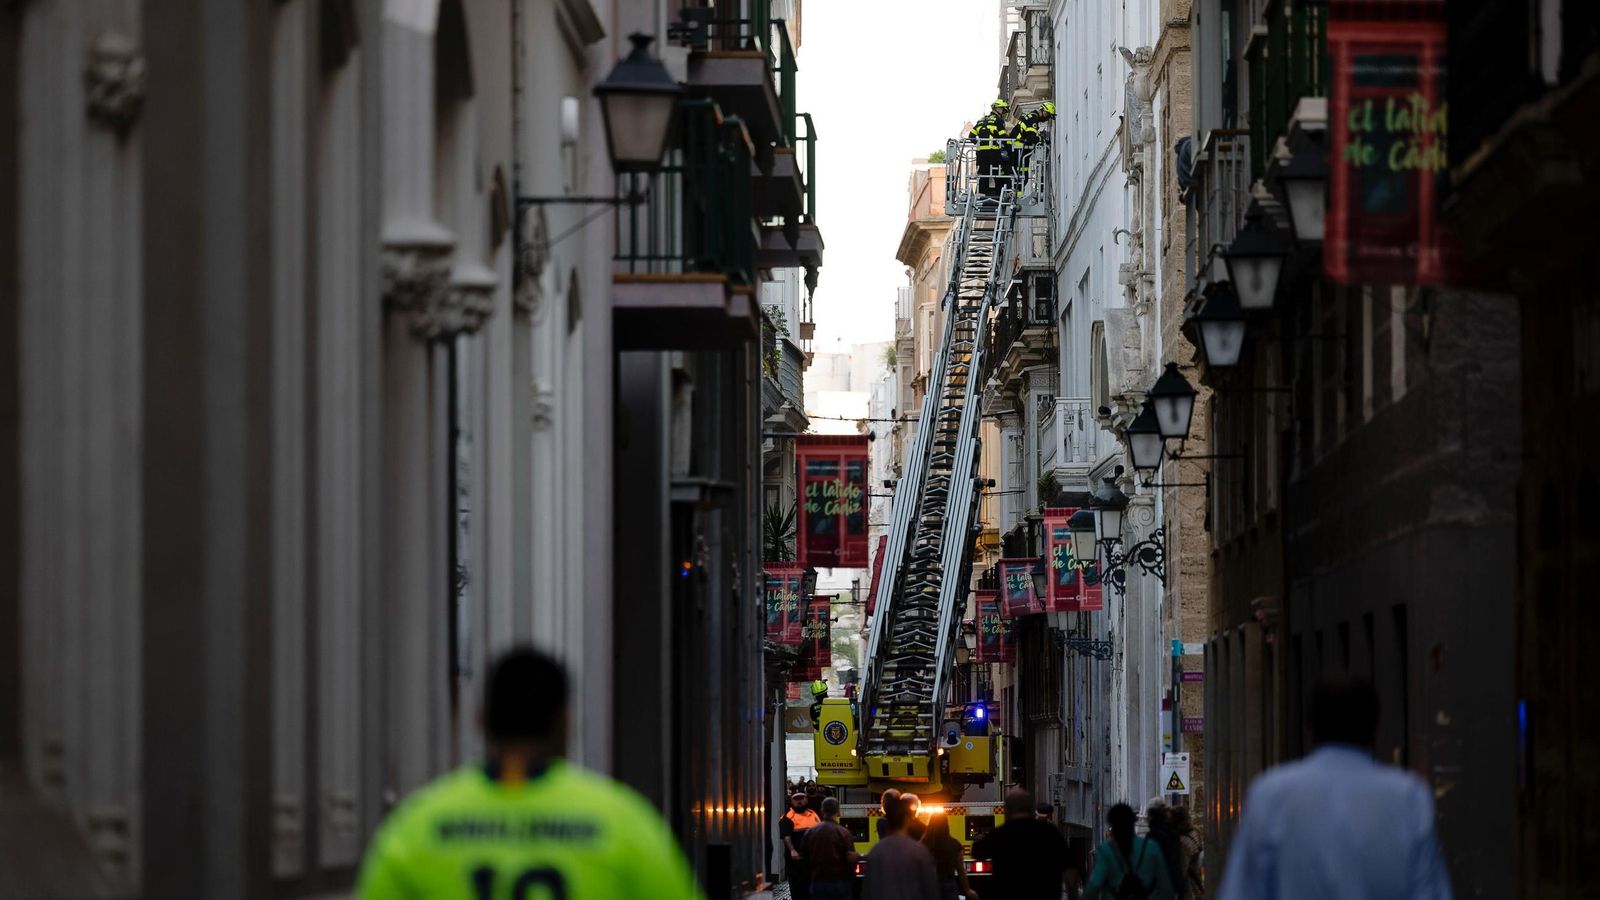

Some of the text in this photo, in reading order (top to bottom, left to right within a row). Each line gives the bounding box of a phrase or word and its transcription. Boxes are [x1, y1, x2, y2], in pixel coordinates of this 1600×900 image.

[1348, 90, 1448, 135] el latid
[1342, 136, 1448, 173] de Cádi
[805, 478, 862, 499] el latido
[804, 497, 862, 516] de Cádiz
[1052, 543, 1064, 557] el
[1051, 557, 1065, 570] de
[1006, 573, 1015, 582] el
[773, 588, 798, 602] latido
